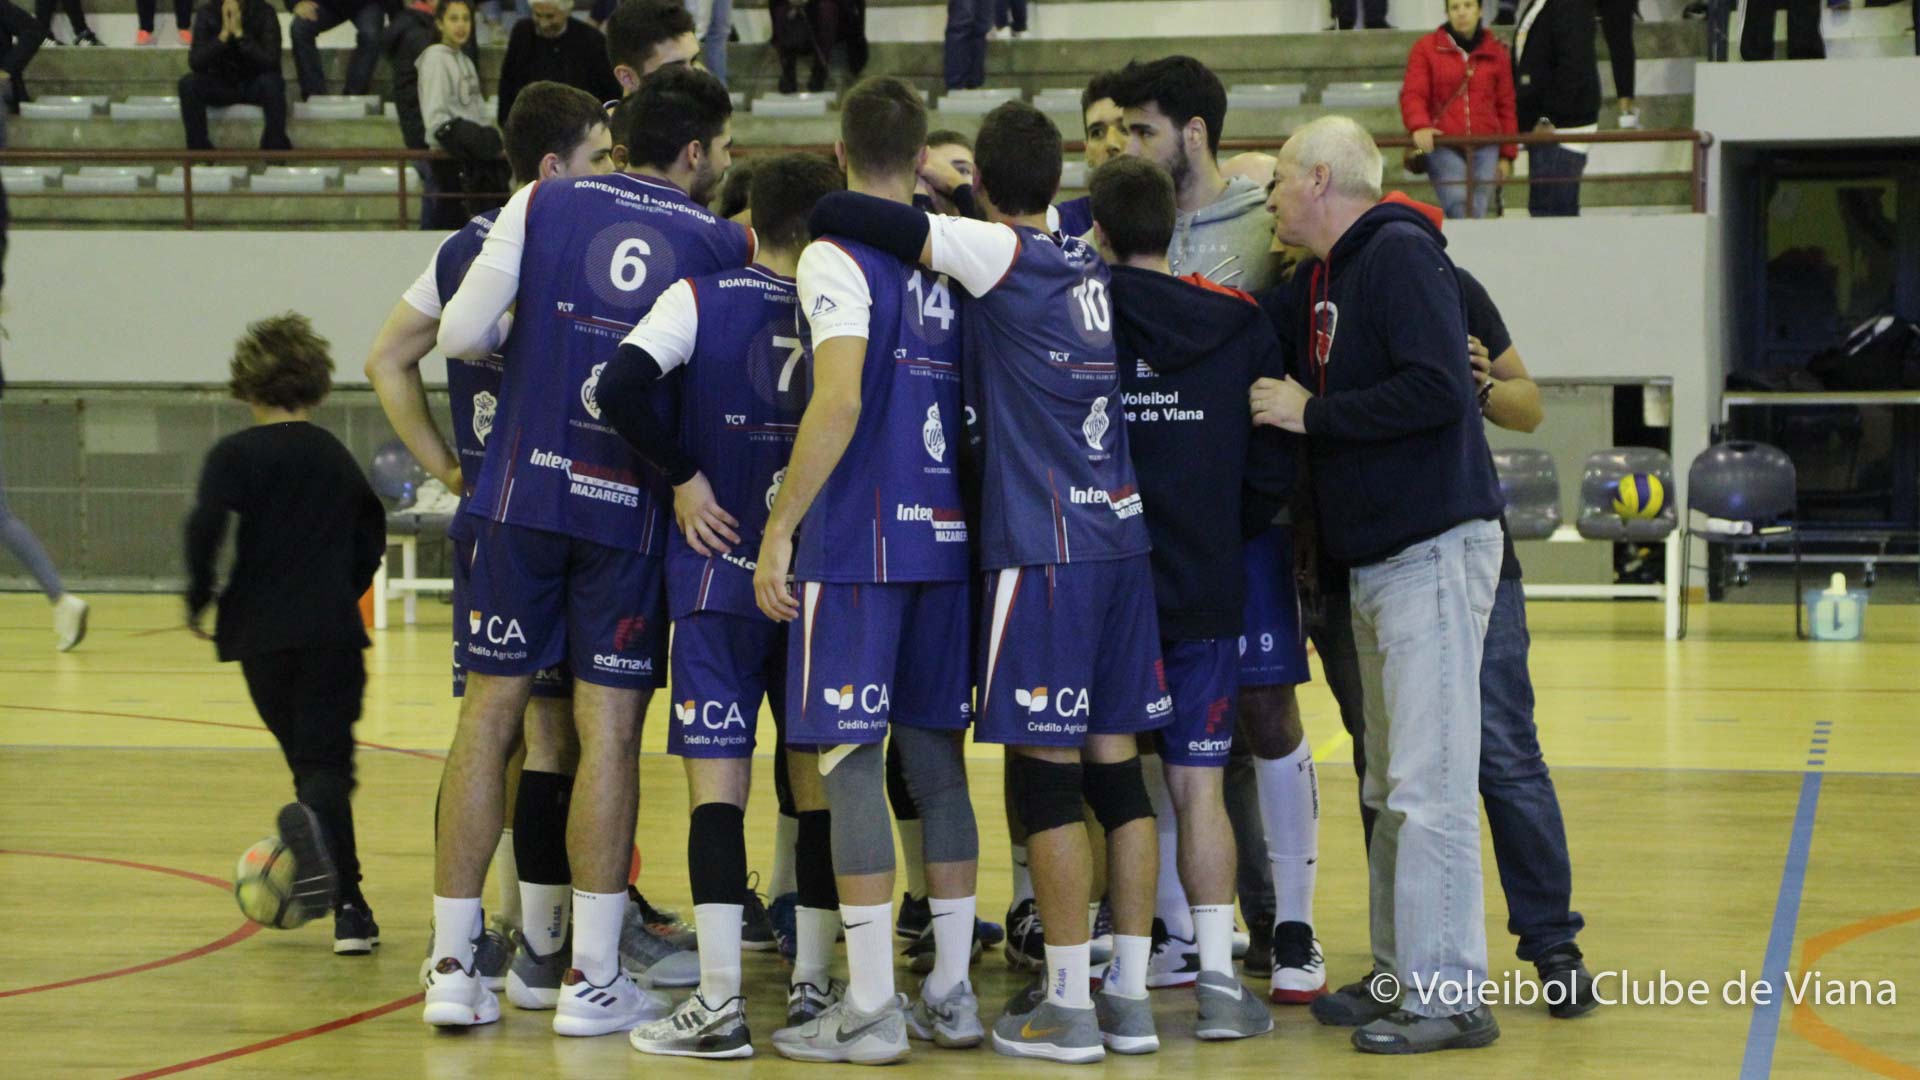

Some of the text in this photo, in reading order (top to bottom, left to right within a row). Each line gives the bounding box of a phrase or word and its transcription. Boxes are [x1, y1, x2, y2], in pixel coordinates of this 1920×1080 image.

[574, 180, 640, 202] BOAVENTURA
[609, 238, 651, 291] 6
[907, 269, 955, 330] 14
[1072, 277, 1110, 333] 10
[772, 335, 801, 392] 7
[1120, 391, 1179, 405] Voleibol
[1140, 408, 1159, 422] de
[1163, 407, 1204, 422] Viana
[570, 482, 639, 508] MAZAREFES
[487, 615, 527, 645] CA
[1260, 632, 1273, 652] 9
[861, 683, 890, 714] CA
[1056, 687, 1090, 717] CA
[702, 700, 746, 729] CA
[838, 720, 868, 730] Crédito
[1028, 721, 1062, 732] Crédito
